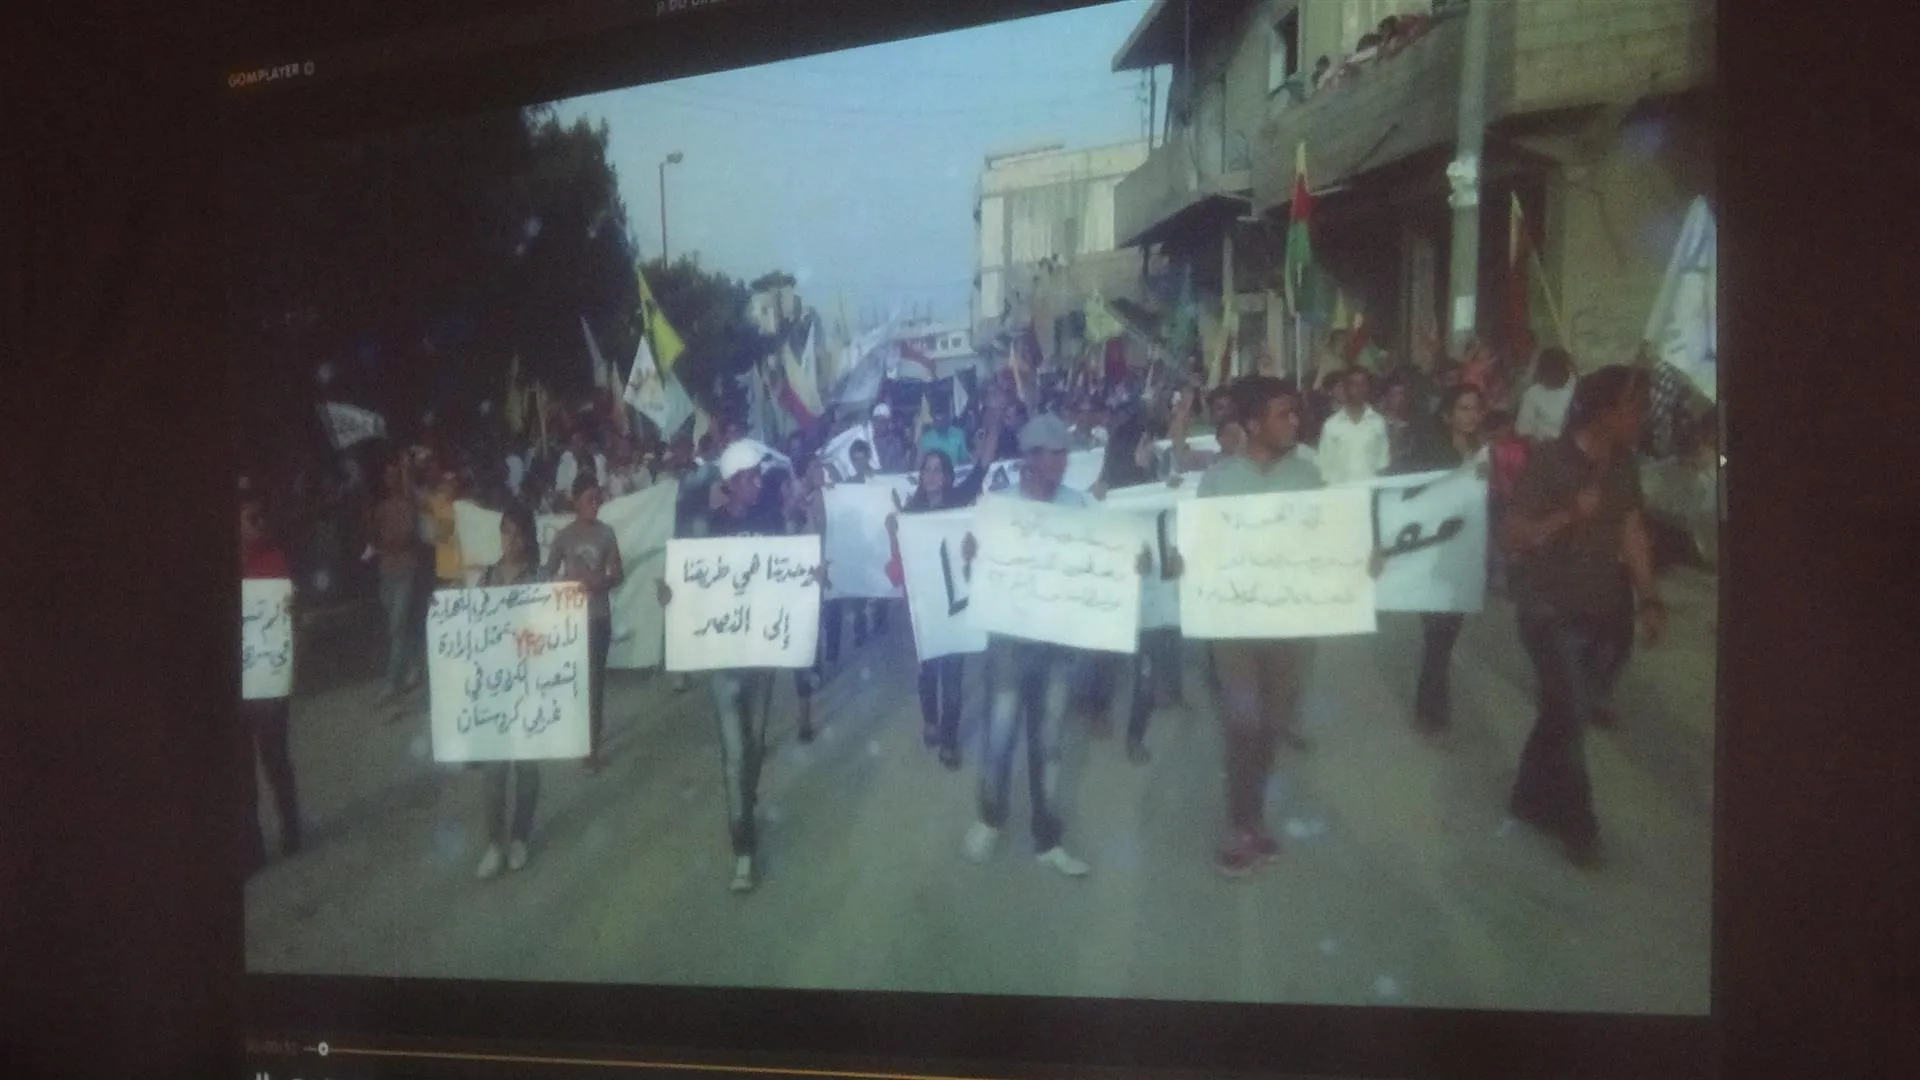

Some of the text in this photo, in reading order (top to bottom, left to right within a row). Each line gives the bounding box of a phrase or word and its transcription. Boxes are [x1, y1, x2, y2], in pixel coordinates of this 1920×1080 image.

[227, 63, 299, 88] GOMPLAYER
[683, 555, 731, 589] طريقنا
[731, 552, 761, 596] هي
[554, 585, 586, 612] YPG
[692, 604, 790, 651] إلى النصر
